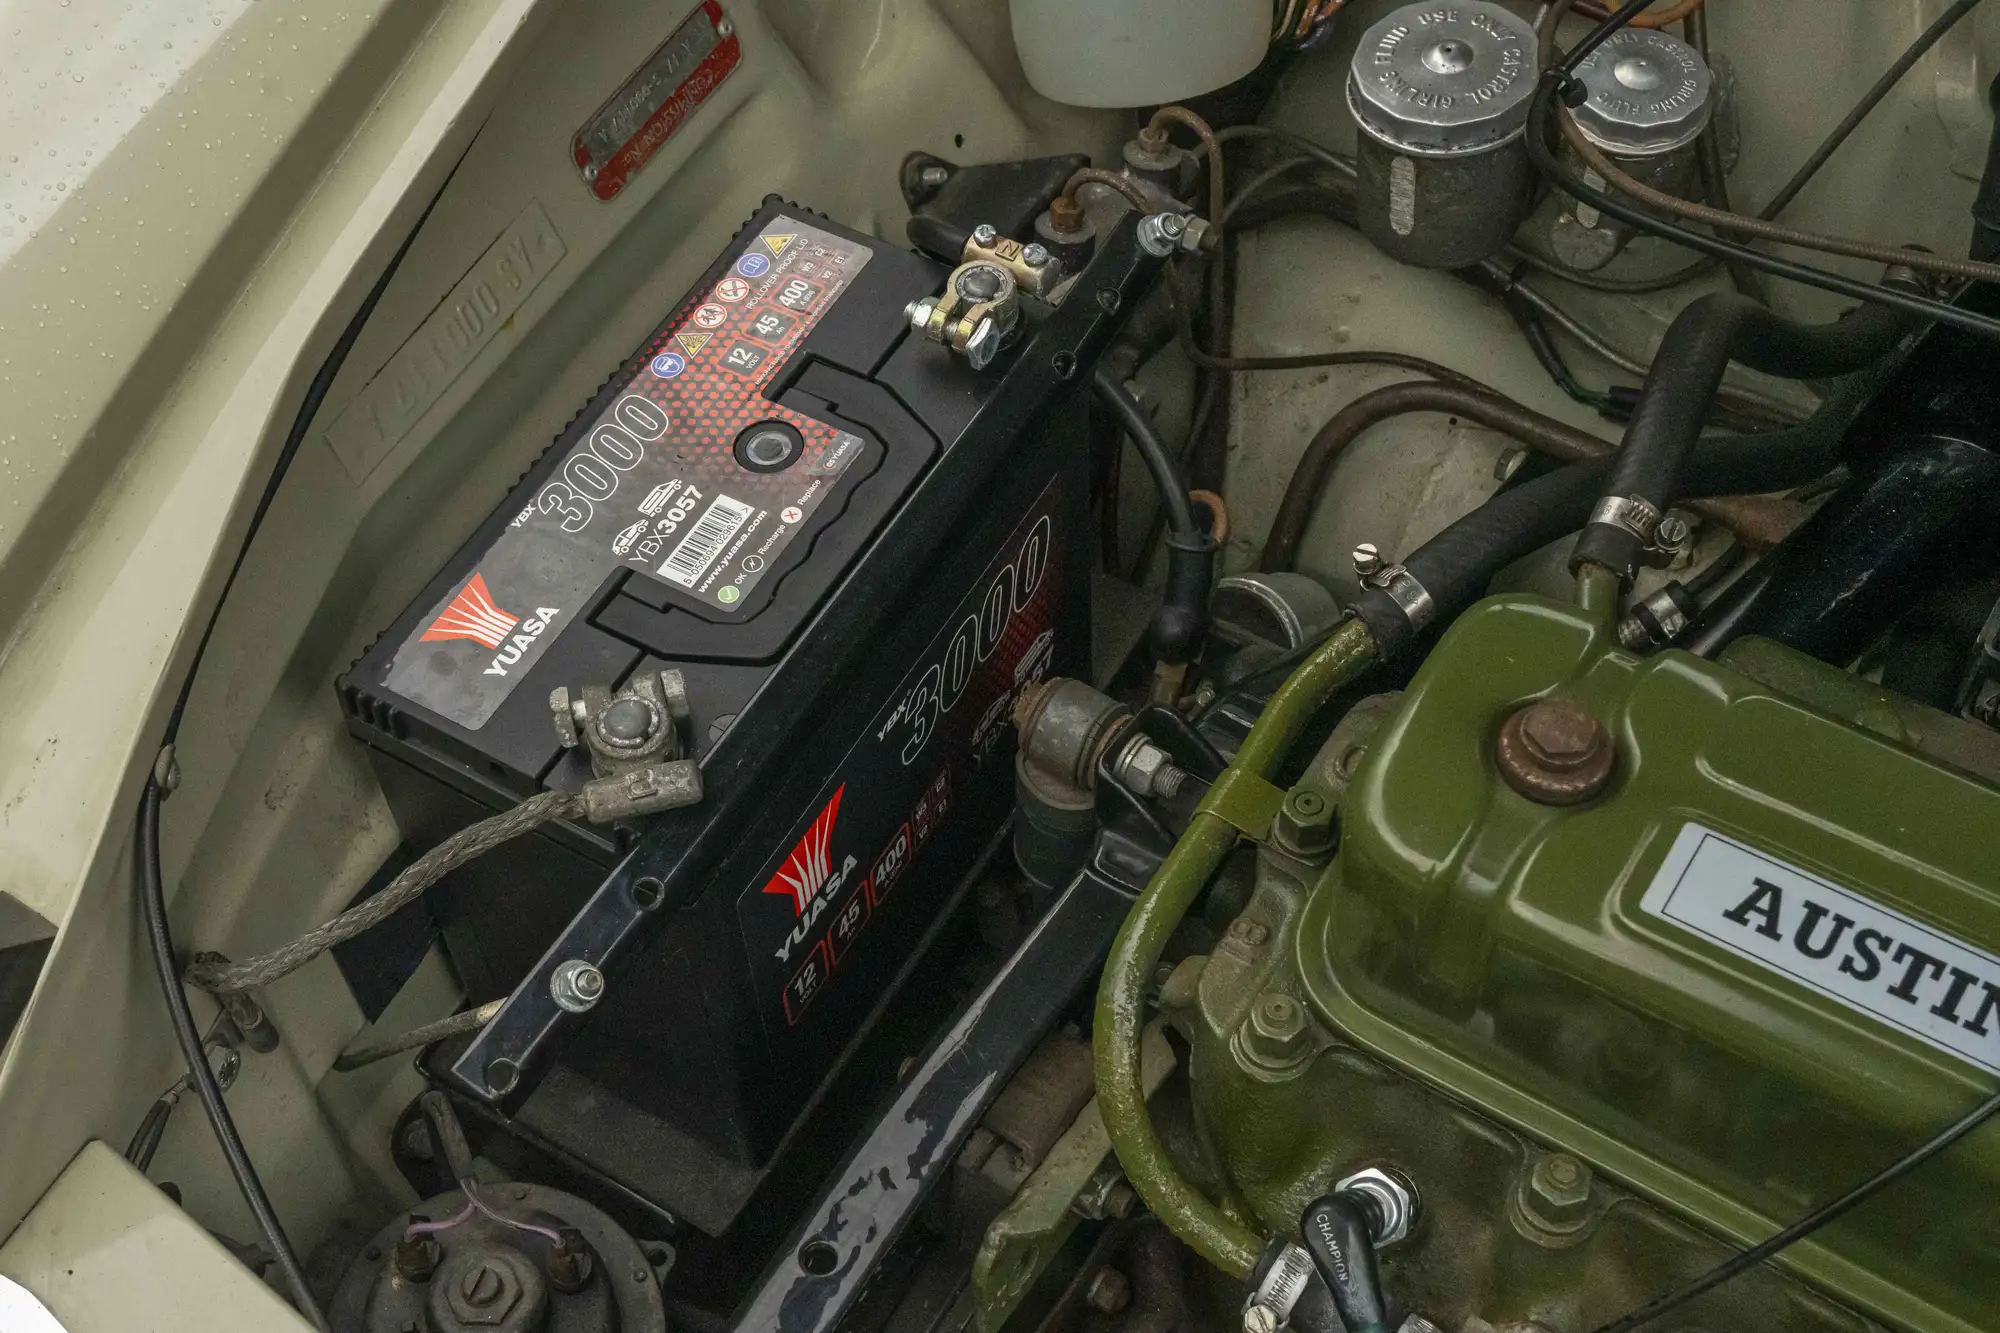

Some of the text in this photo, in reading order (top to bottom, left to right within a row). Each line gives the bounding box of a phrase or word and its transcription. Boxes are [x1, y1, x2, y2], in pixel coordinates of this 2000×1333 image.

[1417, 10, 1460, 25] USE
[1471, 14, 1517, 41] ONLY
[1374, 26, 1410, 66] FLUID
[1647, 35, 1698, 75] CASTROL
[1465, 48, 1523, 104] CASTROL
[1650, 79, 1698, 114] GIRLING
[745, 237, 810, 311] ROLLOVER PROOF LID
[779, 279, 809, 308] 400
[755, 314, 780, 335] 45
[727, 347, 752, 366] 12
[745, 356, 761, 370] VOLT
[510, 394, 670, 533] YBX 3000
[796, 478, 822, 507] Replace
[628, 484, 704, 566] YBX3057
[690, 544, 718, 575] 050694
[716, 515, 744, 545] 029615
[757, 523, 787, 556] Recharge
[697, 509, 769, 594] www.yuasa.com
[734, 571, 748, 586] OK
[482, 605, 561, 678] YUASA
[876, 514, 1051, 766] YBX 3000
[875, 833, 908, 888] 400
[774, 853, 859, 963] YUASA
[838, 899, 861, 940] 45
[794, 961, 817, 997] 12
[1315, 1213, 1350, 1282] CHAMPION
